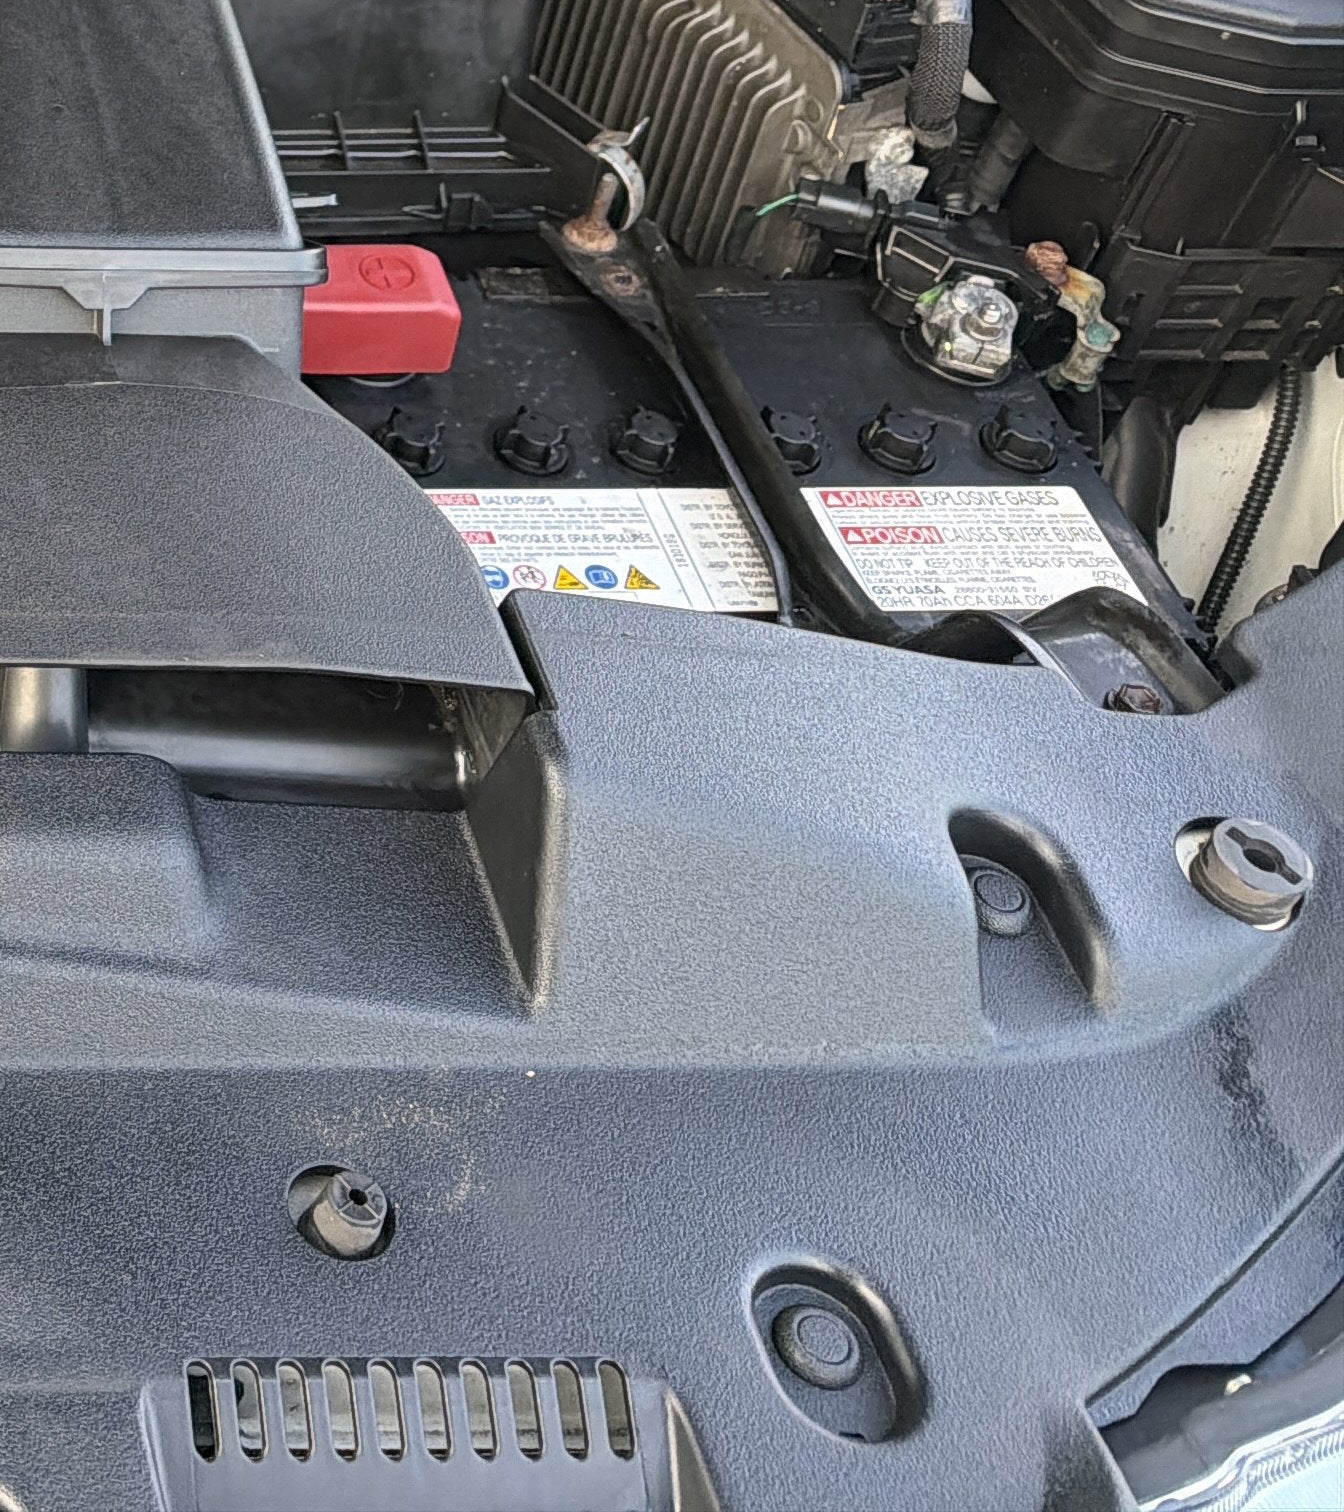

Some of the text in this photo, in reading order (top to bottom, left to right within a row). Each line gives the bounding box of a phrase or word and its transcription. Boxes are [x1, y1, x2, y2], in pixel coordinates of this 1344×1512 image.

[428, 494, 478, 506] ANGER
[839, 491, 1059, 507] DANGER EXPLOSIVE GASES
[461, 532, 491, 544] SON
[860, 526, 1103, 544] POISON CAUSES SEVERE BURNS
[876, 558, 895, 569] NOT
[953, 558, 974, 568] OUT
[976, 558, 989, 568] OF
[991, 557, 1013, 568] THE
[871, 585, 946, 595] GS YUASA
[877, 596, 915, 607] 20HR
[919, 596, 952, 607] 70Ah
[954, 595, 986, 607] CCA
